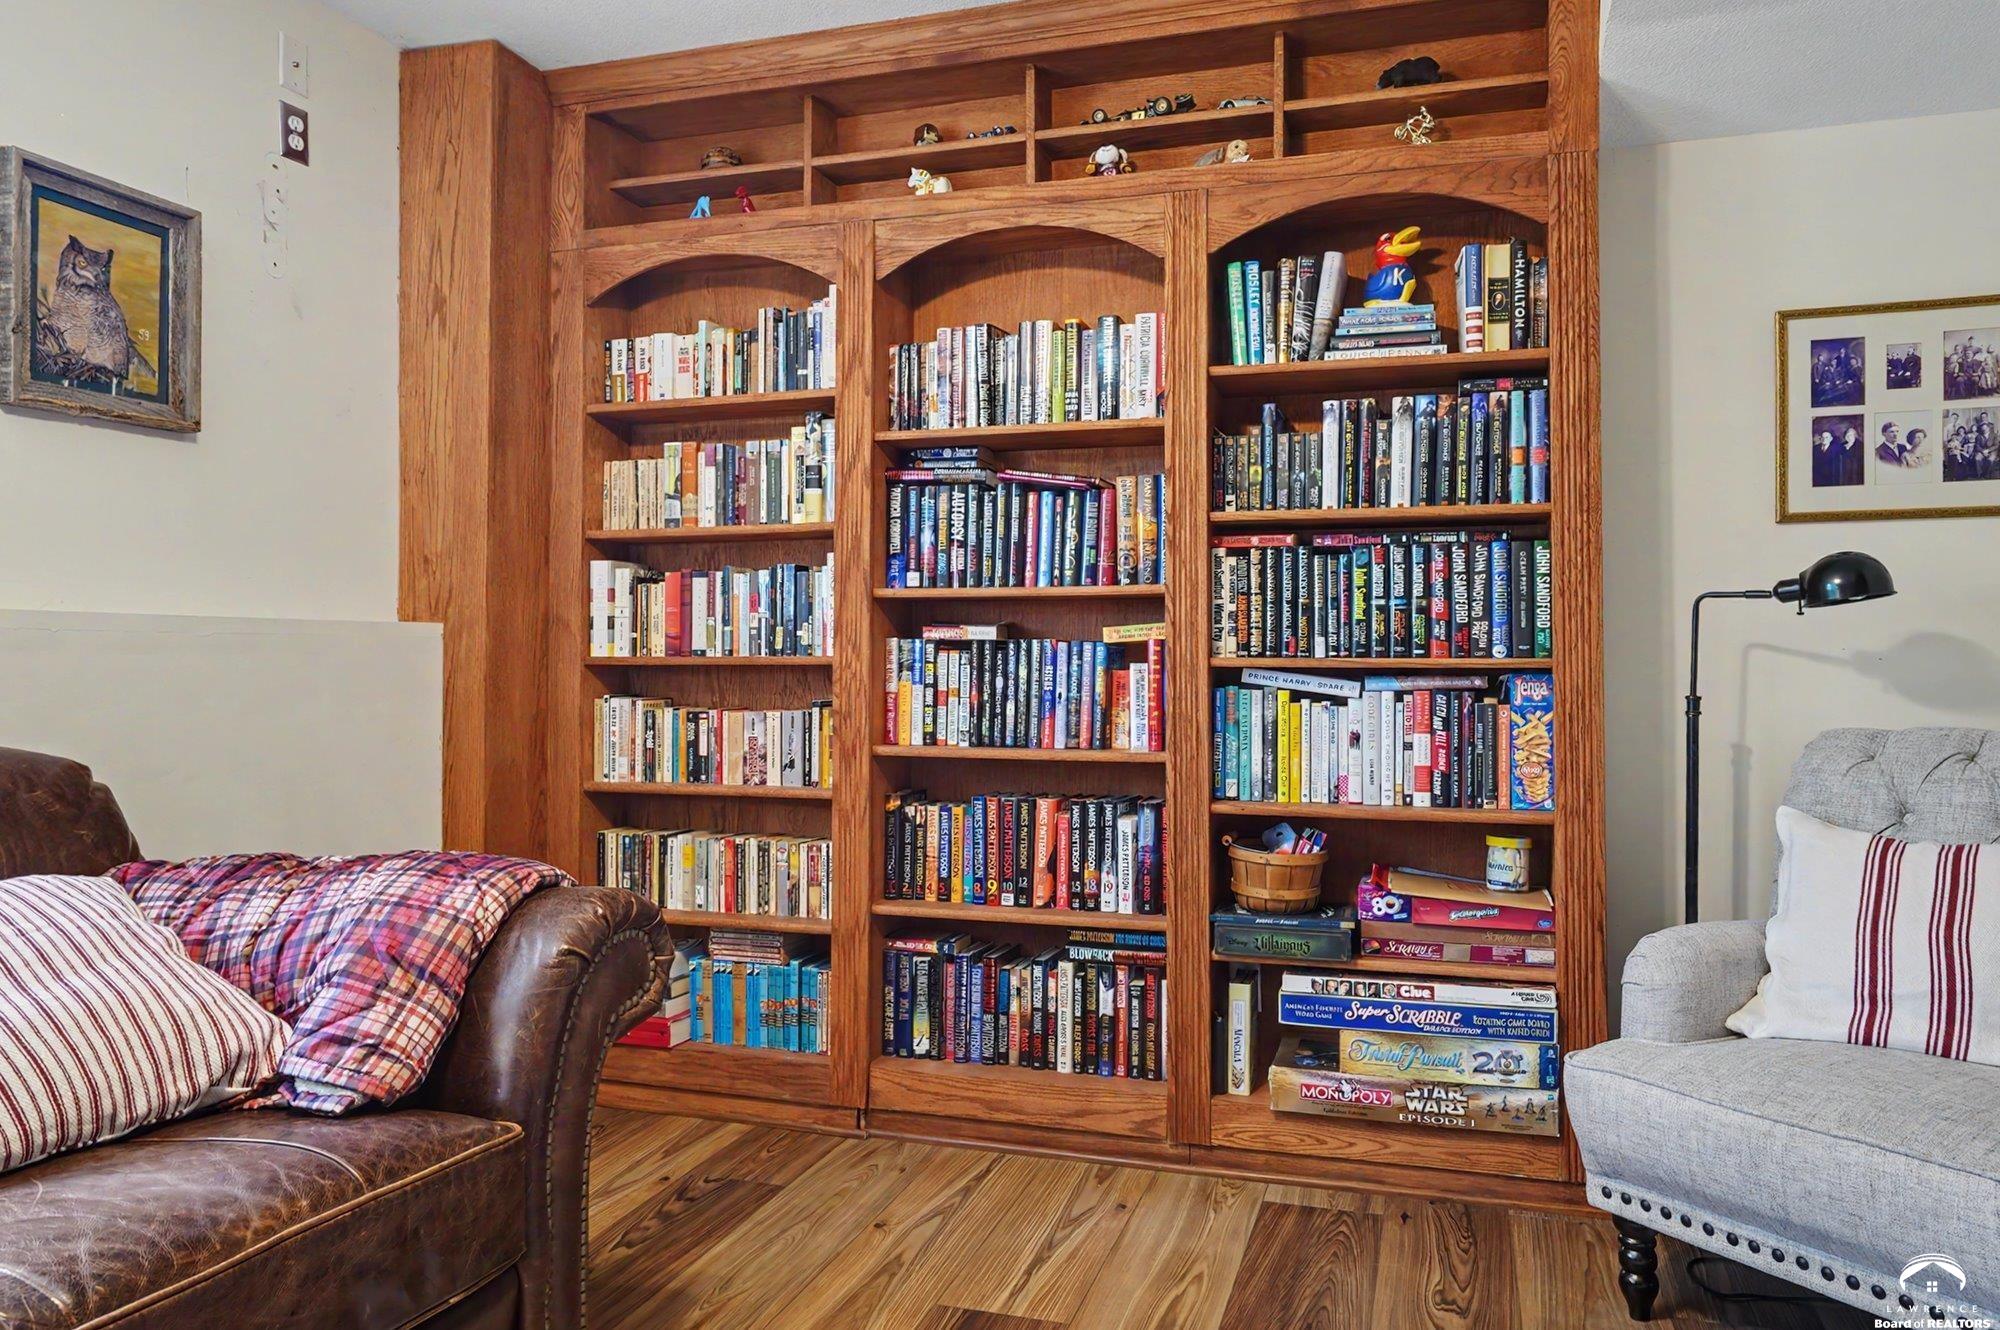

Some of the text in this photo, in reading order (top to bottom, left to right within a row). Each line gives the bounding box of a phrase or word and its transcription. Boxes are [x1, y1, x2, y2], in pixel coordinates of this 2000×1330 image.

[1392, 267, 1405, 285] K
[1515, 260, 1525, 328] HAMILTON
[1140, 316, 1150, 386] PATRICIA CORNWELL
[1144, 478, 1152, 497] DAN
[890, 488, 900, 517] PATRICIA
[951, 492, 965, 540] AUTOPSY
[890, 519, 900, 554] CORNWELL
[1087, 518, 1098, 546] BROWN
[1471, 545, 1487, 572] JOHN
[1494, 546, 1507, 572] JOHN
[1394, 547, 1405, 596] JOHN SANDFORD
[1435, 548, 1443, 612] JOHN SANDFORD
[1214, 570, 1224, 600] Sandford
[1453, 546, 1468, 623] JOHN SANDFORD
[1471, 574, 1487, 617] SANDFORD
[1355, 588, 1367, 620] Sandford
[1494, 574, 1507, 622] SANDFORD
[1044, 665, 1053, 691] REICHS
[1247, 671, 1344, 692] PRINCE HARRY SPARE
[1514, 678, 1549, 704] Jenga
[1436, 694, 1446, 716] CATCH
[1436, 730, 1448, 746] KILL
[940, 812, 948, 878] JAMES PATTERSON
[974, 801, 983, 878] JAMES PATTERSON
[988, 802, 996, 878] JAMES PATTERSON
[1004, 802, 1012, 878] JAMES PATTERSON
[1020, 803, 1029, 870] JAMES PATTERSON
[1039, 801, 1047, 868] JAMES PATTERSON
[1072, 806, 1080, 872] JAMES PATTERSON
[902, 882, 910, 892] 2
[938, 882, 946, 893] 5
[973, 882, 981, 893] 8
[988, 878, 998, 896] 9
[1003, 882, 1013, 892] 10
[1019, 876, 1028, 886] 12
[1087, 879, 1097, 892] 18
[1104, 882, 1113, 893] 19
[917, 960, 928, 970] CAT
[1069, 948, 1114, 962] BLOWBACK
[917, 976, 928, 996] MOUSE
[971, 968, 981, 985] FOUR
[1399, 985, 1432, 999] Clue
[885, 1004, 894, 1016] CAME
[971, 1004, 981, 1018] MICE
[1345, 1002, 1463, 1028] Super SCRABBLE
[1473, 1015, 1504, 1027] ROTATING
[1506, 1018, 1526, 1028] GAME
[1033, 1011, 1042, 1034] DOUBLE
[1088, 1014, 1096, 1036] CROSS
[1487, 1026, 1505, 1036] WITH
[956, 1022, 966, 1058] PATTERSON
[971, 1026, 981, 1058] PATTERSON
[982, 1022, 994, 1058] PATTERSON
[1033, 1035, 1042, 1057] CROSS
[1348, 1039, 1462, 1070] Trivial Pursuit
[1301, 1084, 1392, 1105] MONOPOLY
[1405, 1082, 1464, 1099] STAR
[1406, 1098, 1469, 1116] WARS
[1399, 1113, 1468, 1127] EPISODE
